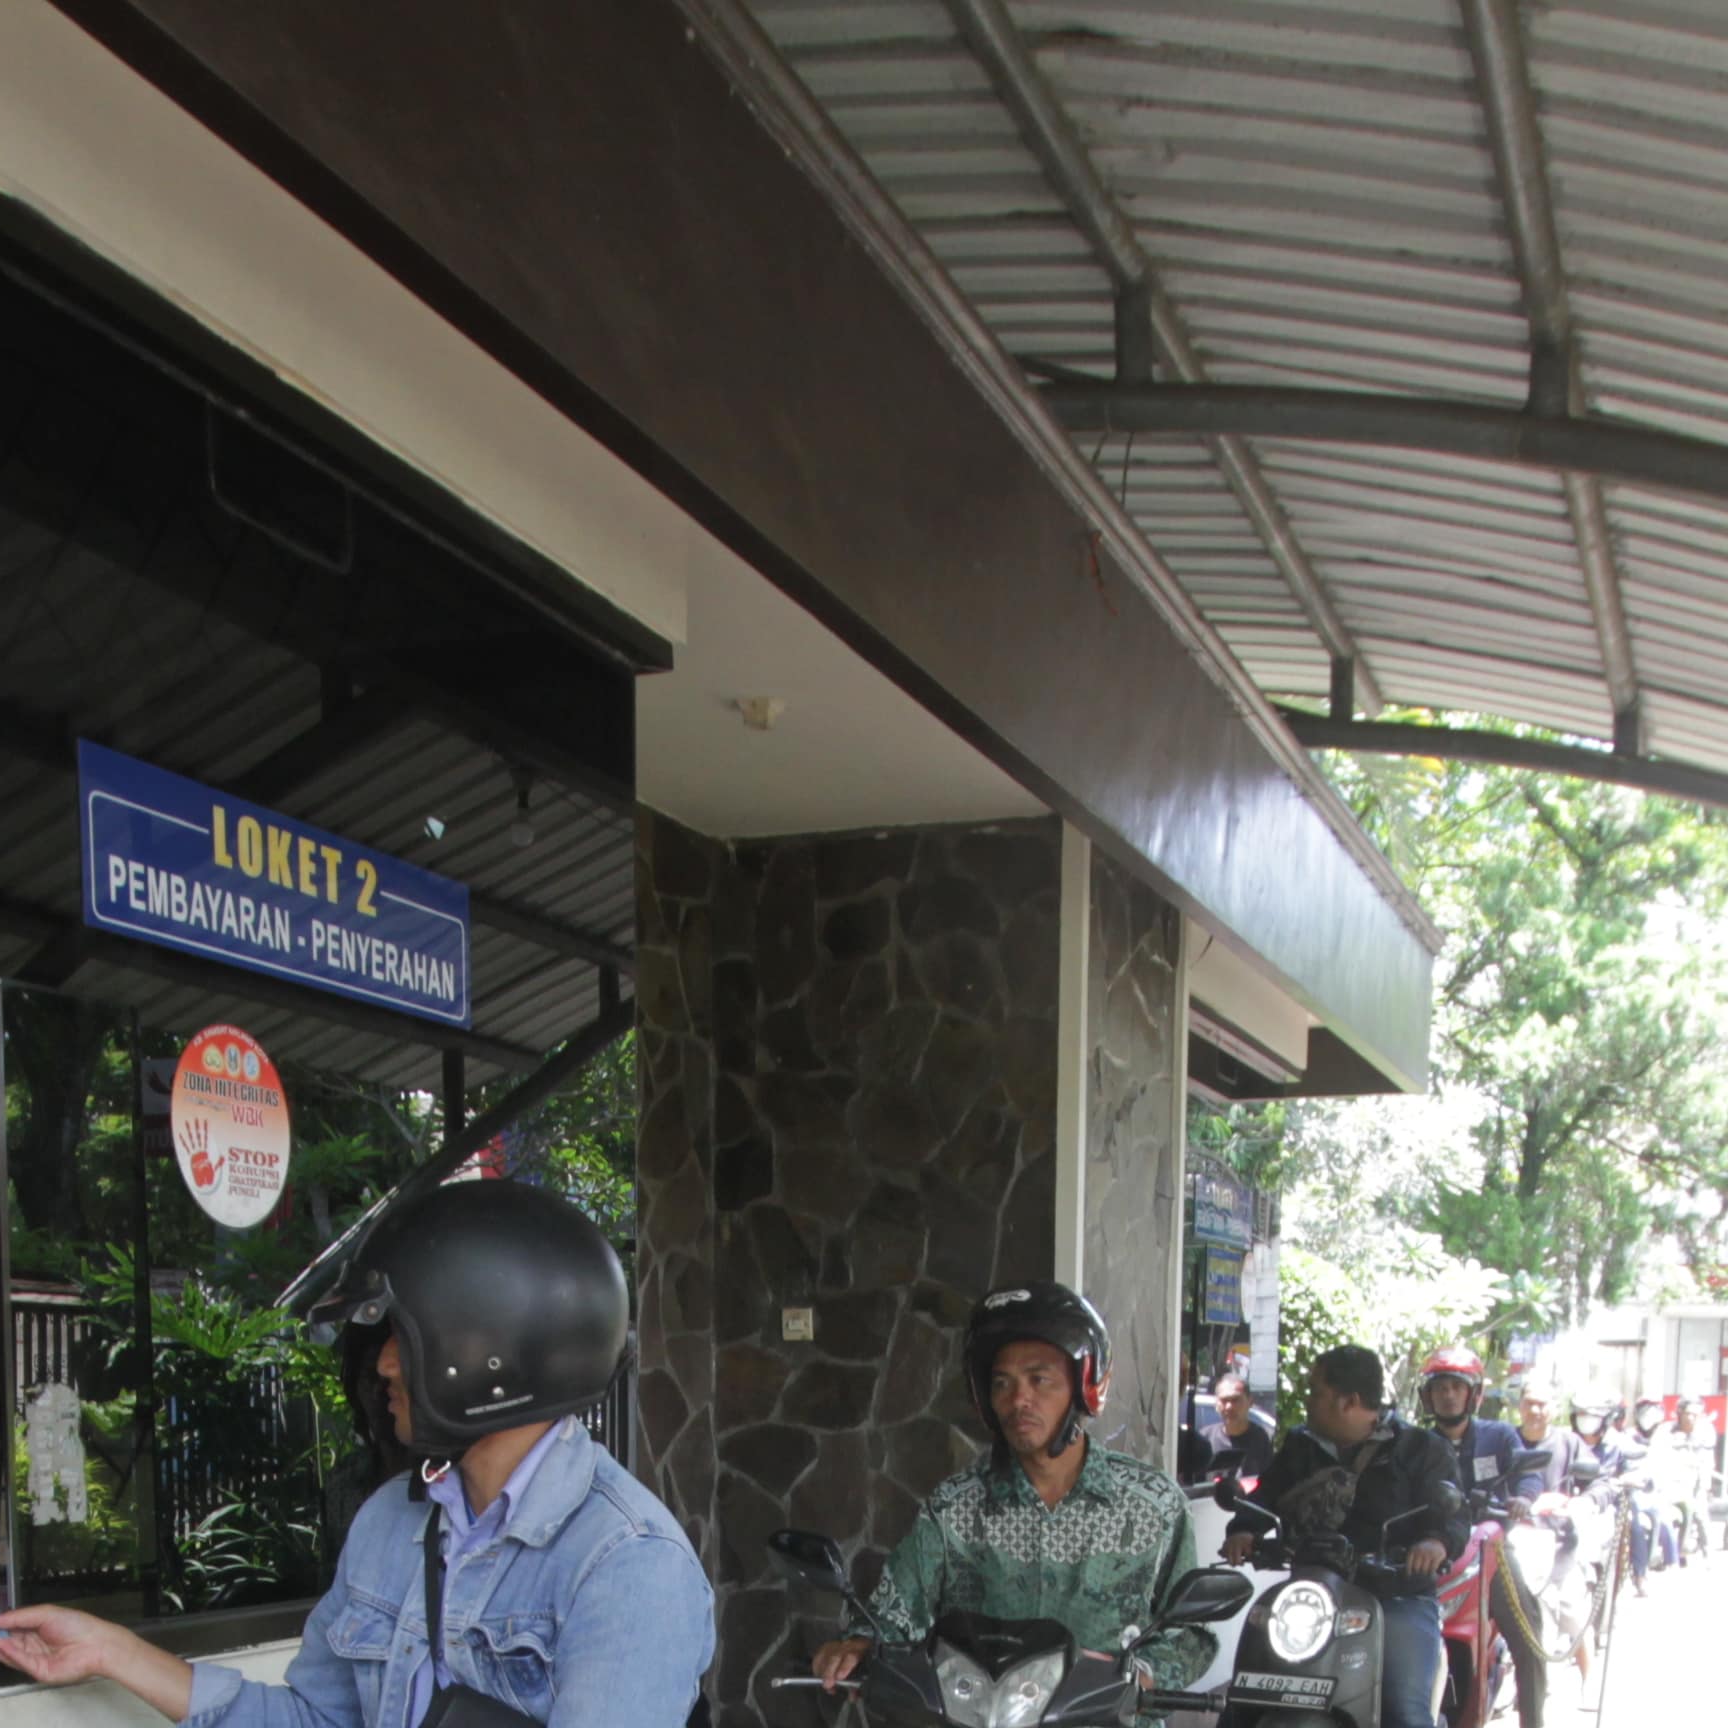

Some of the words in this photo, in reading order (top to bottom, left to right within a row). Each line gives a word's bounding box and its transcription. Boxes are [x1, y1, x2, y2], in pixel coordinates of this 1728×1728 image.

[213, 804, 343, 905] LOKET
[355, 859, 378, 917] 2
[107, 854, 291, 952] PEMBAYARAN
[311, 917, 455, 1002] PENYERAHAN
[183, 1071, 212, 1095] ZONA
[215, 1079, 279, 1107] INTEGRITAS
[228, 1147, 280, 1168] STOP
[1239, 1675, 1249, 1688] N
[1256, 1677, 1294, 1692] 4092
[1300, 1680, 1332, 1696] EAH
